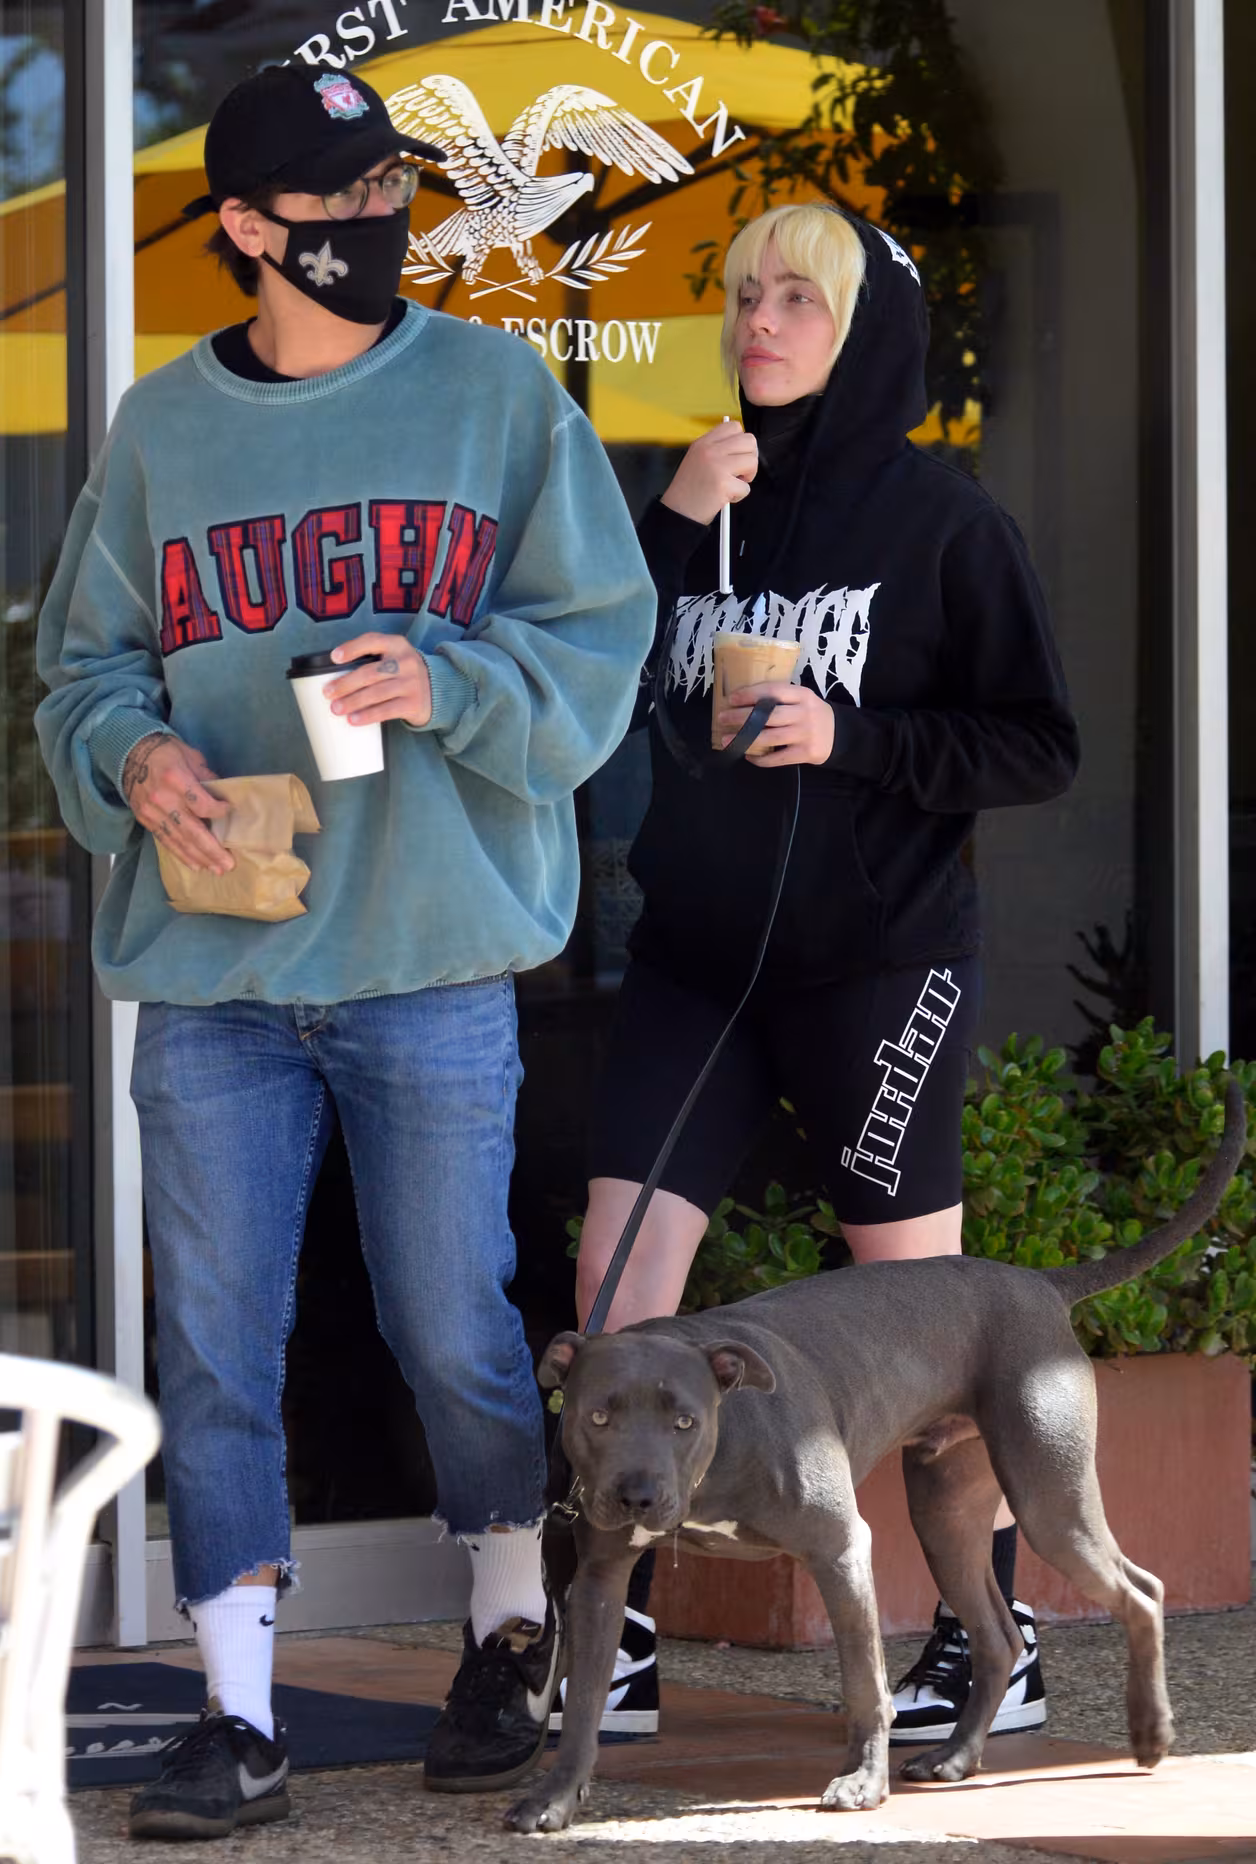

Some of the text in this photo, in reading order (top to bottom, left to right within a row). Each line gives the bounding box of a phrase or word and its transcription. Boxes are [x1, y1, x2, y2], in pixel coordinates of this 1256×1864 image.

[281, 0, 746, 158] RST AMERICAN
[160, 498, 499, 658] AUGHN
[841, 967, 961, 1197] jordan
